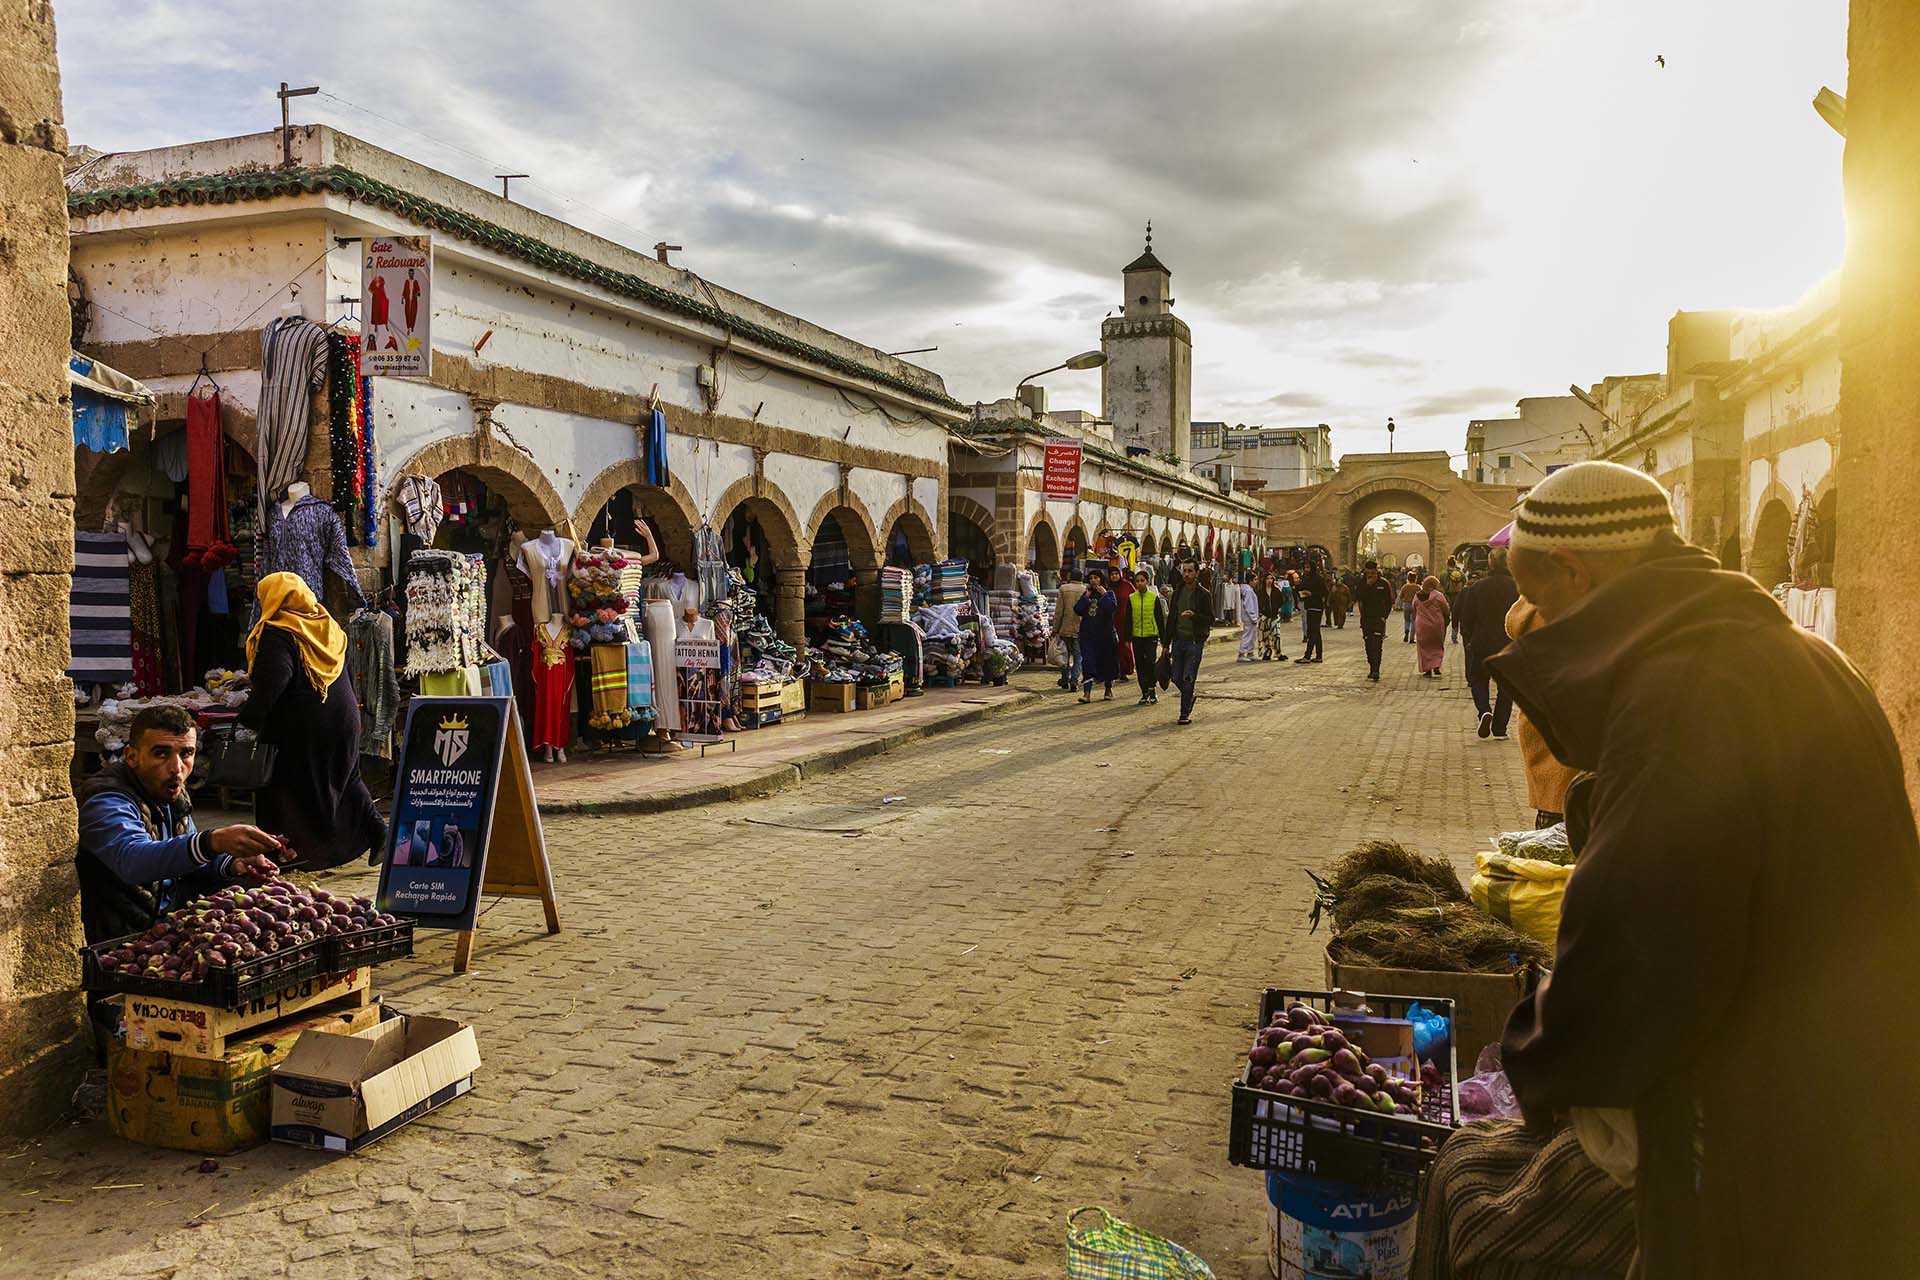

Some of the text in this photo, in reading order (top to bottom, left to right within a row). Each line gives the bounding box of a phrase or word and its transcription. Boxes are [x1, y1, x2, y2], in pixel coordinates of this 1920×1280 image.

[370, 241, 392, 253] Gate
[366, 256, 425, 269] 2 Redouane
[1048, 448, 1079, 457] الصرف
[1049, 458, 1076, 466] Change
[1048, 466, 1075, 474] Cambio
[1045, 475, 1076, 483] Exchange
[698, 649, 719, 658] HENNA
[409, 768, 482, 786] SMARTPHONE
[409, 881, 445, 891] Carte SIM
[395, 890, 457, 902] Recharge Rapide
[1330, 1190, 1412, 1219] ATLAS
